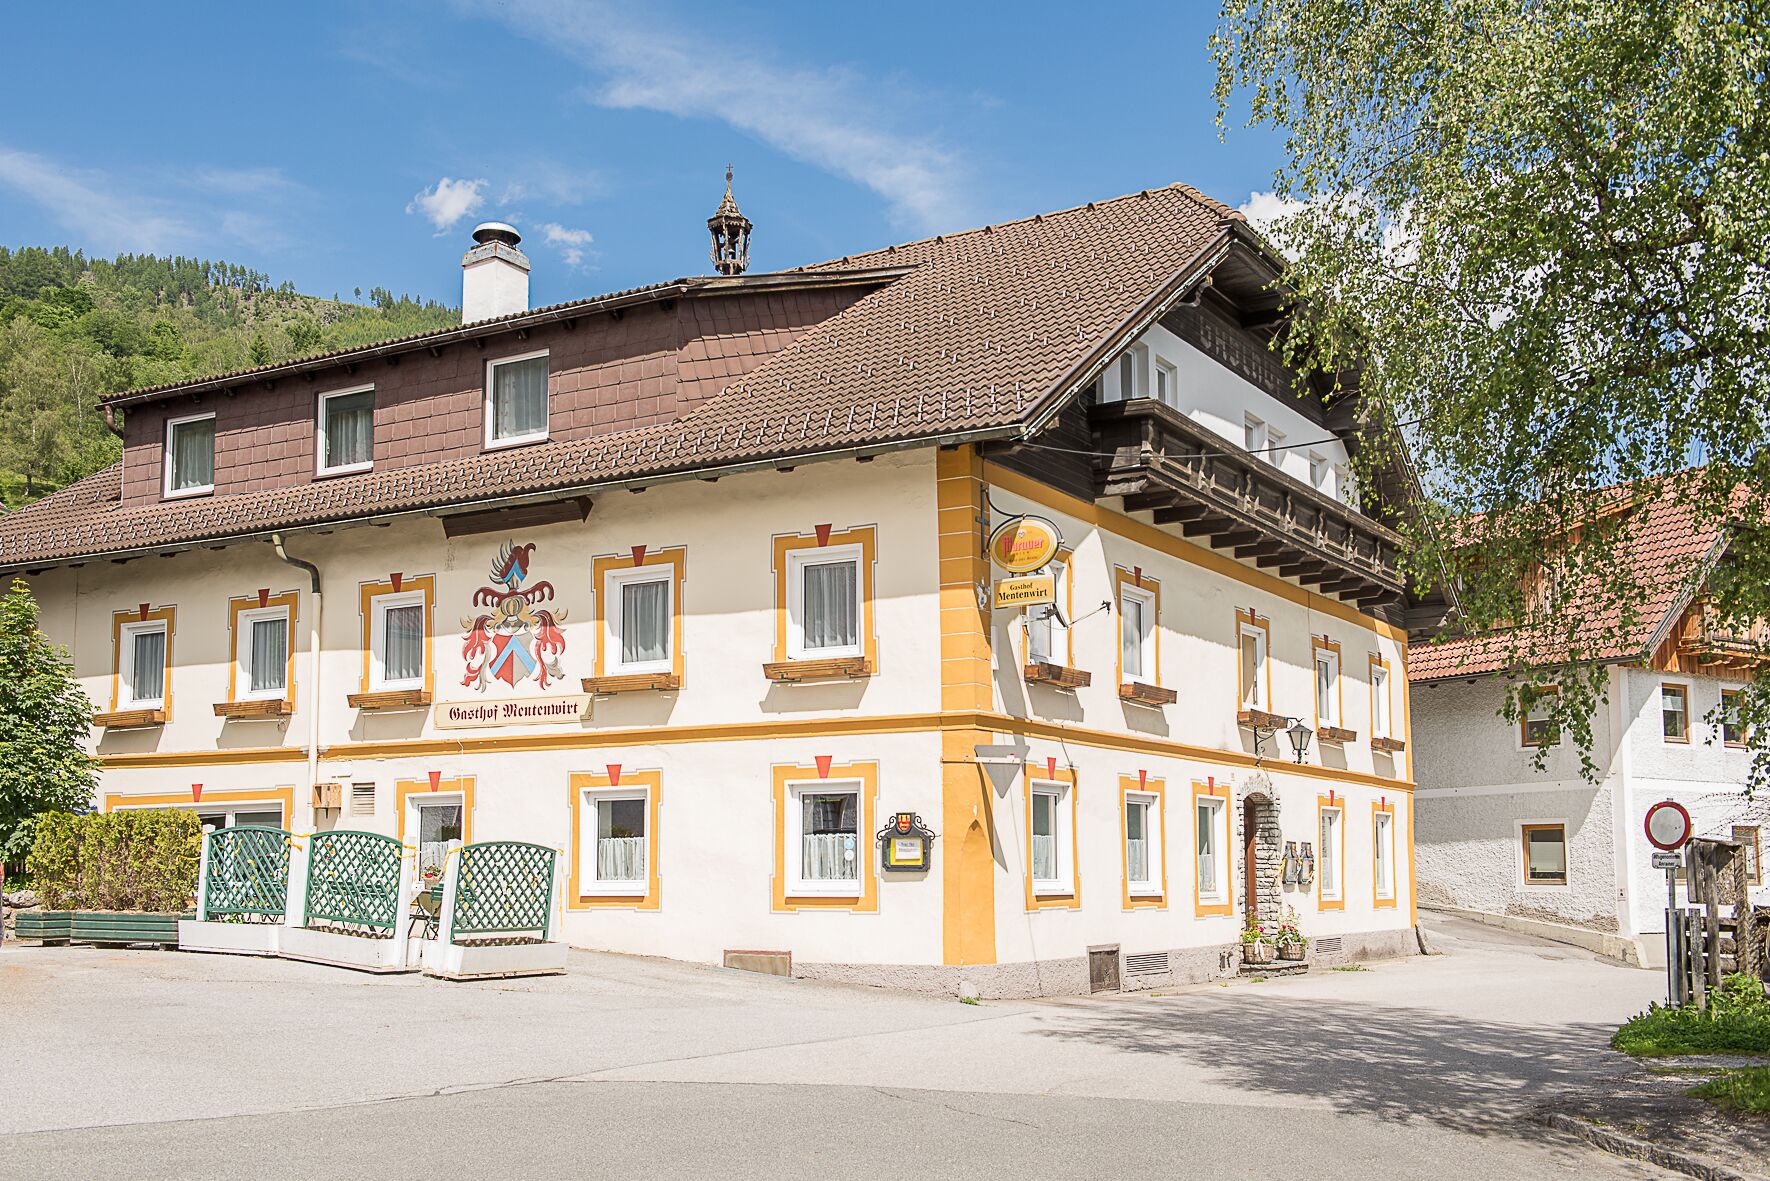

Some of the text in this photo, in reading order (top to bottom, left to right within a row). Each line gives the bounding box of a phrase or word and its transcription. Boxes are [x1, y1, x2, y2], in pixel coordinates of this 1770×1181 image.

[1010, 583, 1033, 591] Gasthof
[999, 588, 1048, 602] Mentenwirt
[449, 701, 578, 722] Gasthof Mentenwirt
